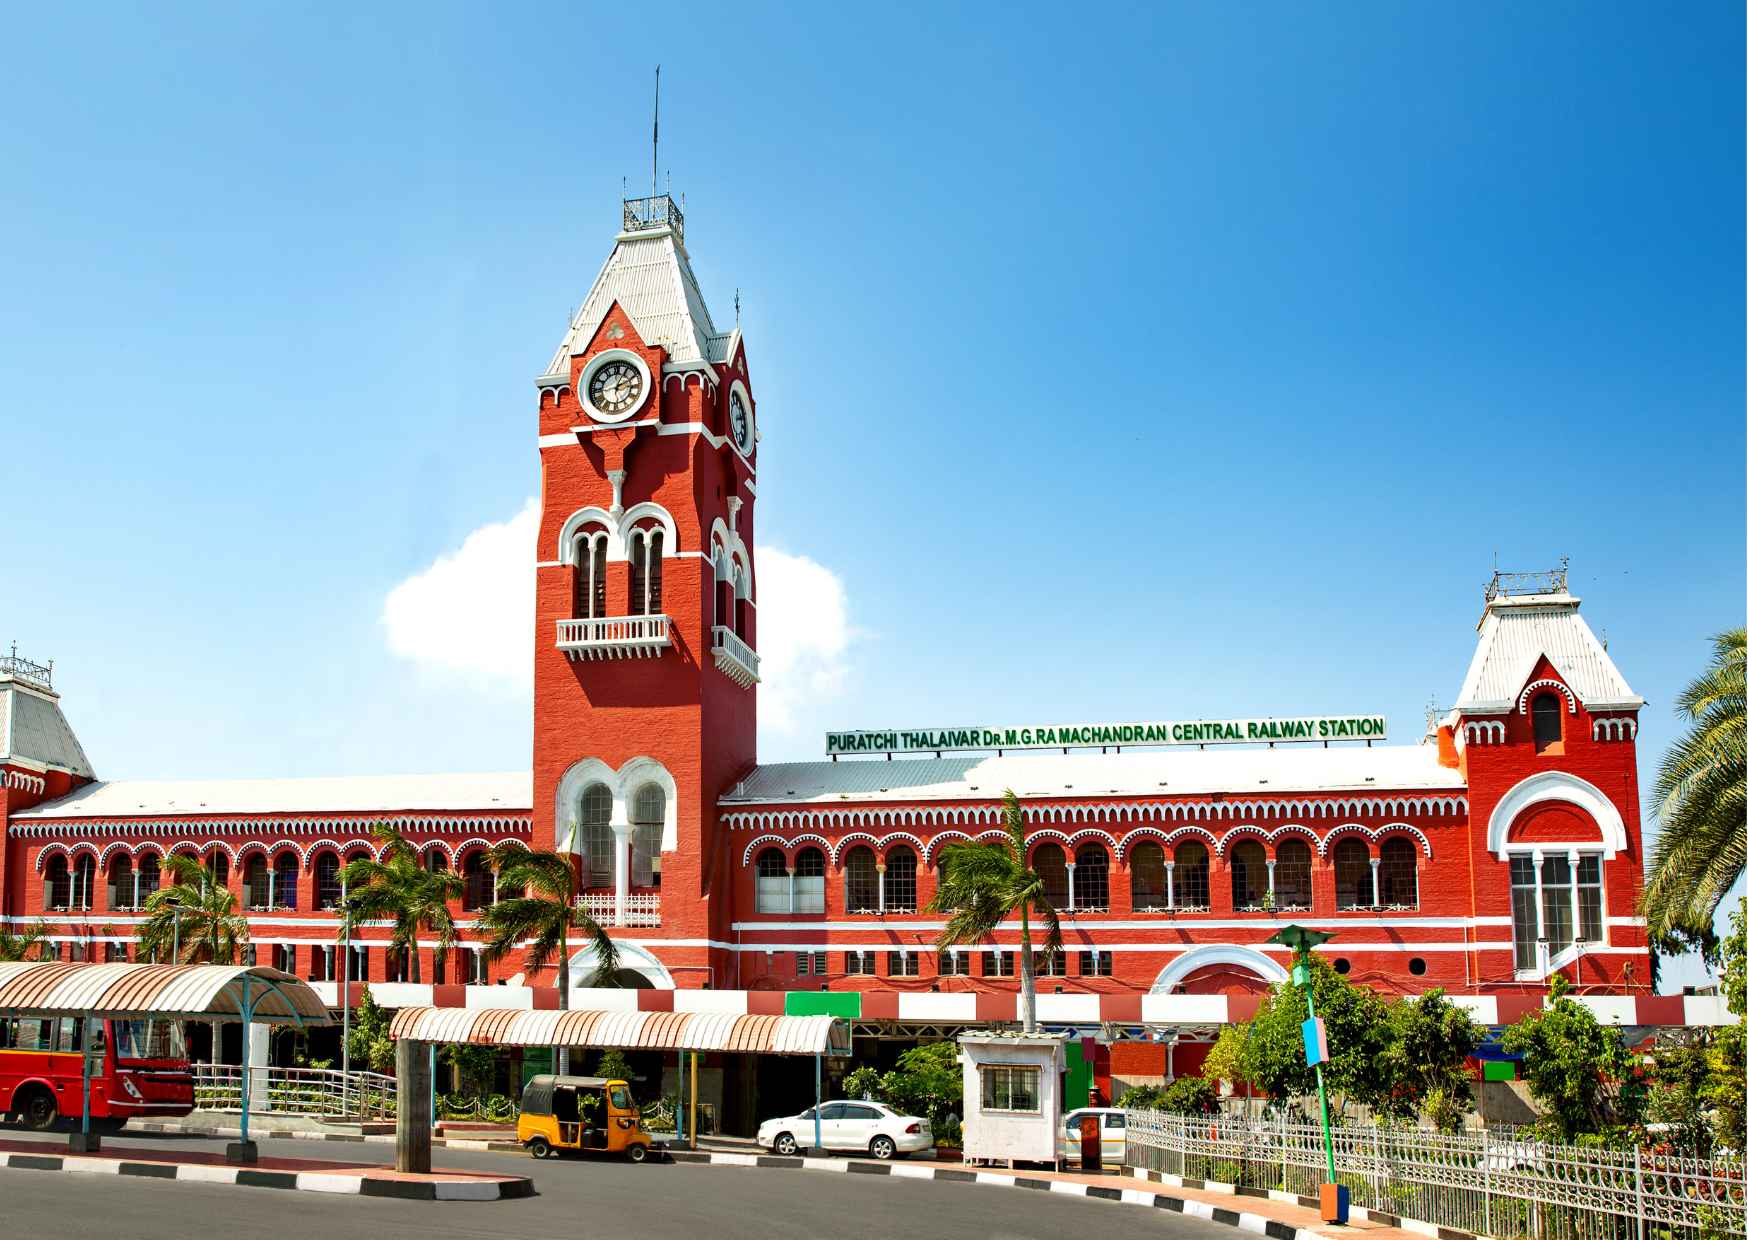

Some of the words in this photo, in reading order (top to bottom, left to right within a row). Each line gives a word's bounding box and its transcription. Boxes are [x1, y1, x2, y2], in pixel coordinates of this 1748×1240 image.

[829, 733, 897, 750] PURATCHI
[901, 730, 981, 748] THALAIVAR
[1172, 722, 1244, 740] CENTRAL
[1247, 720, 1315, 738] RAILWAY
[1319, 718, 1384, 737] STATION
